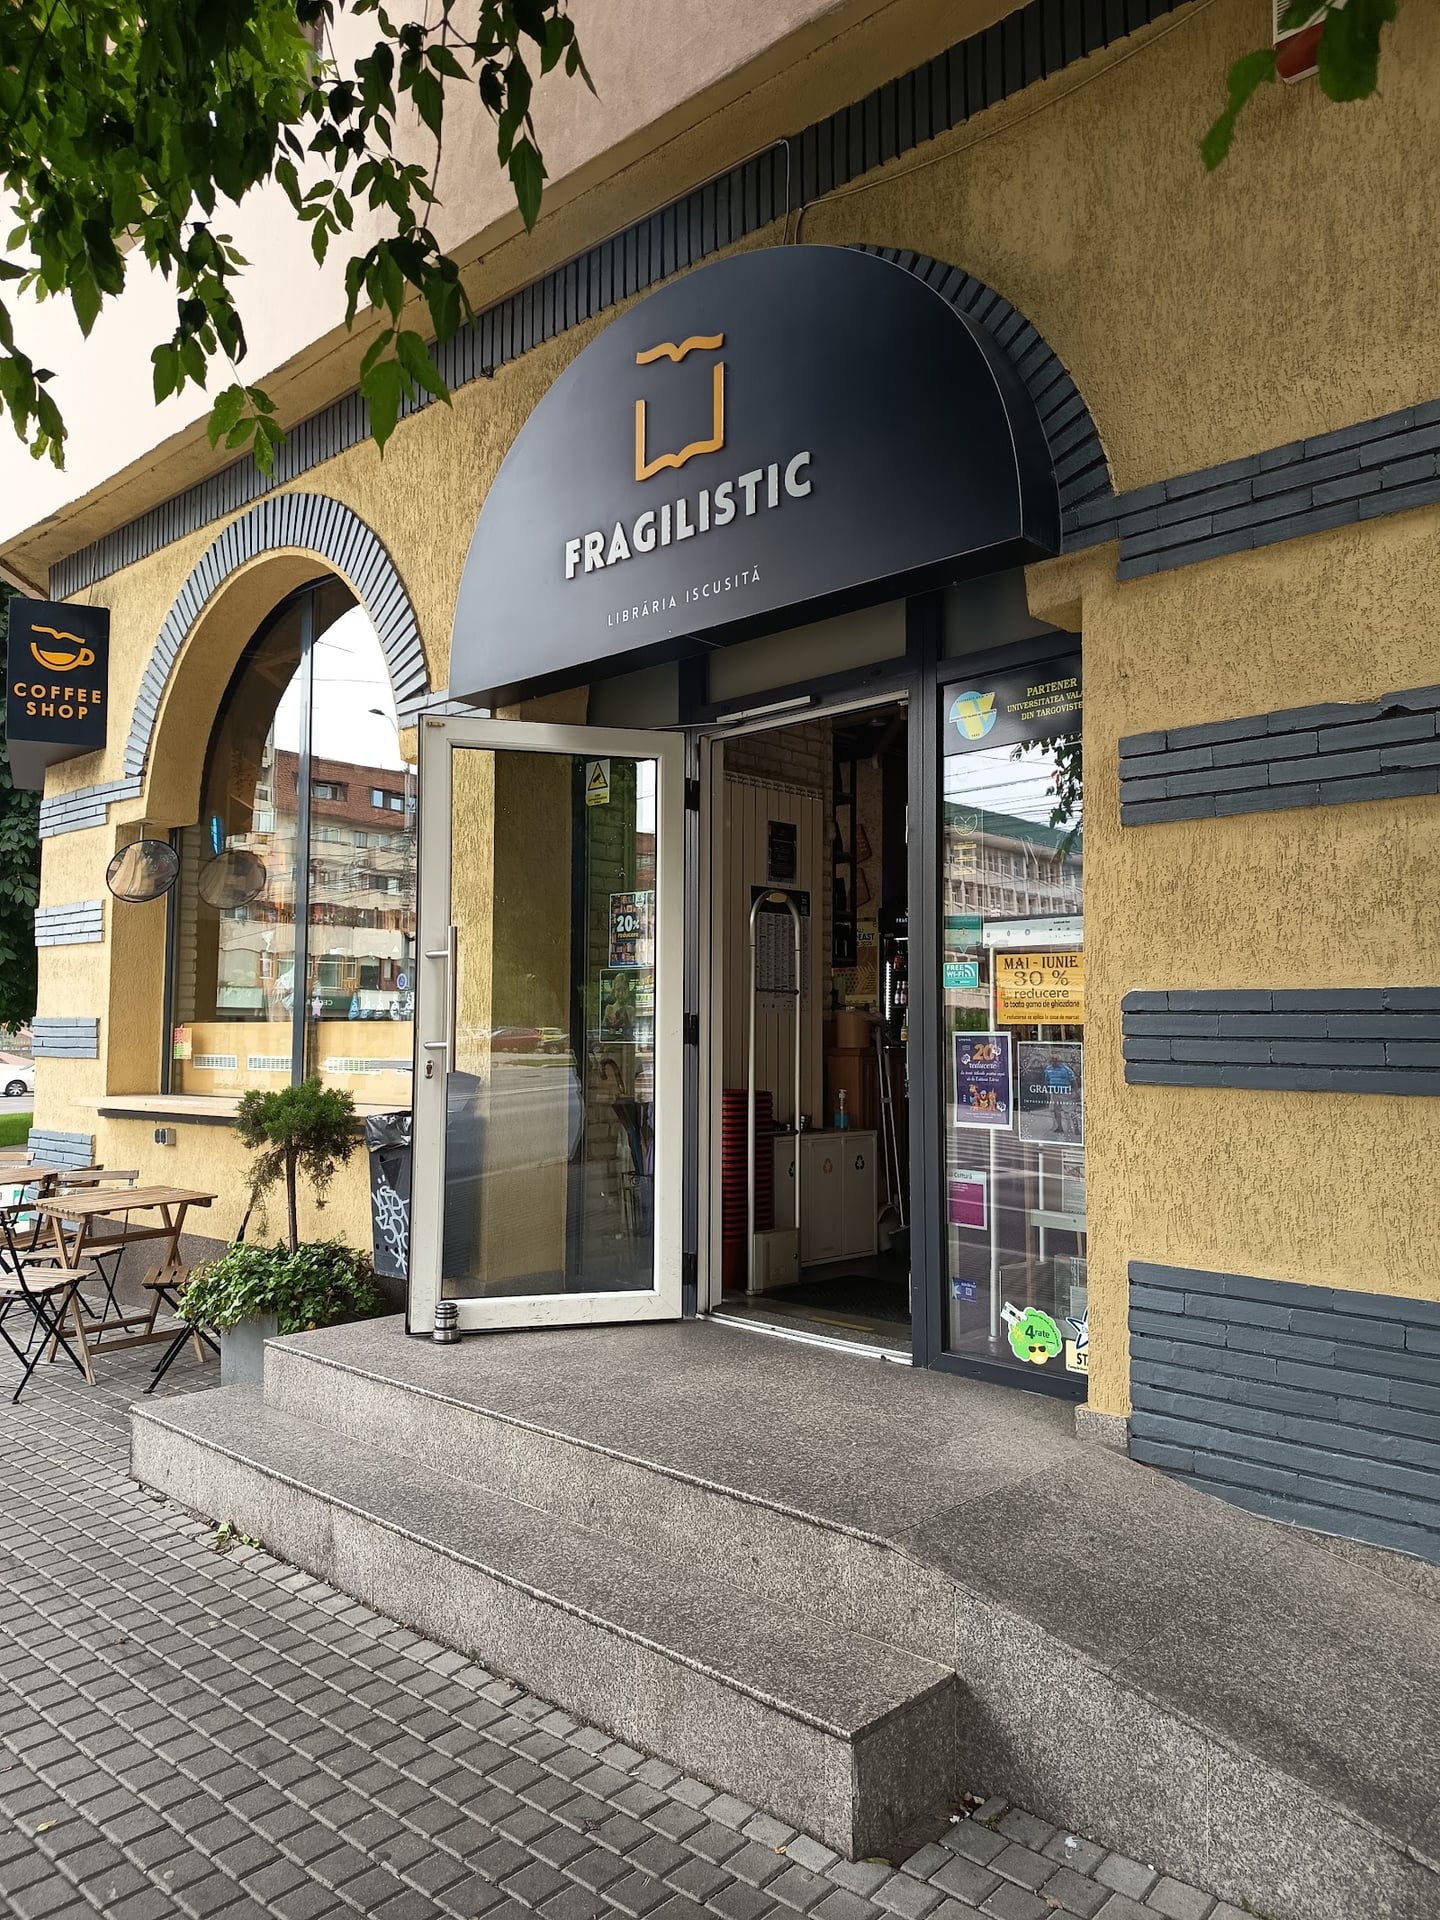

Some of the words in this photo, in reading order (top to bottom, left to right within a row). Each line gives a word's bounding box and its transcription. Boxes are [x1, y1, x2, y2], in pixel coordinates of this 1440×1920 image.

[565, 451, 812, 579] FRAGILISTIC
[686, 564, 761, 602] ISCUSITĂ
[13, 682, 102, 704] COFFEE
[1026, 677, 1078, 697] PARTENER
[26, 701, 89, 720] SHOP
[1007, 694, 1065, 713] UNIVERSITATEA
[1021, 710, 1035, 721] DIN
[1036, 701, 1083, 717] TARGOVISTE
[1004, 957, 1029, 970] MAI
[1042, 955, 1079, 969] IUNIE
[1014, 970, 1044, 987] 30
[1014, 988, 1069, 999] reducere
[1029, 1084, 1072, 1094] GRATUIT!
[1076, 1352, 1088, 1366] ST
